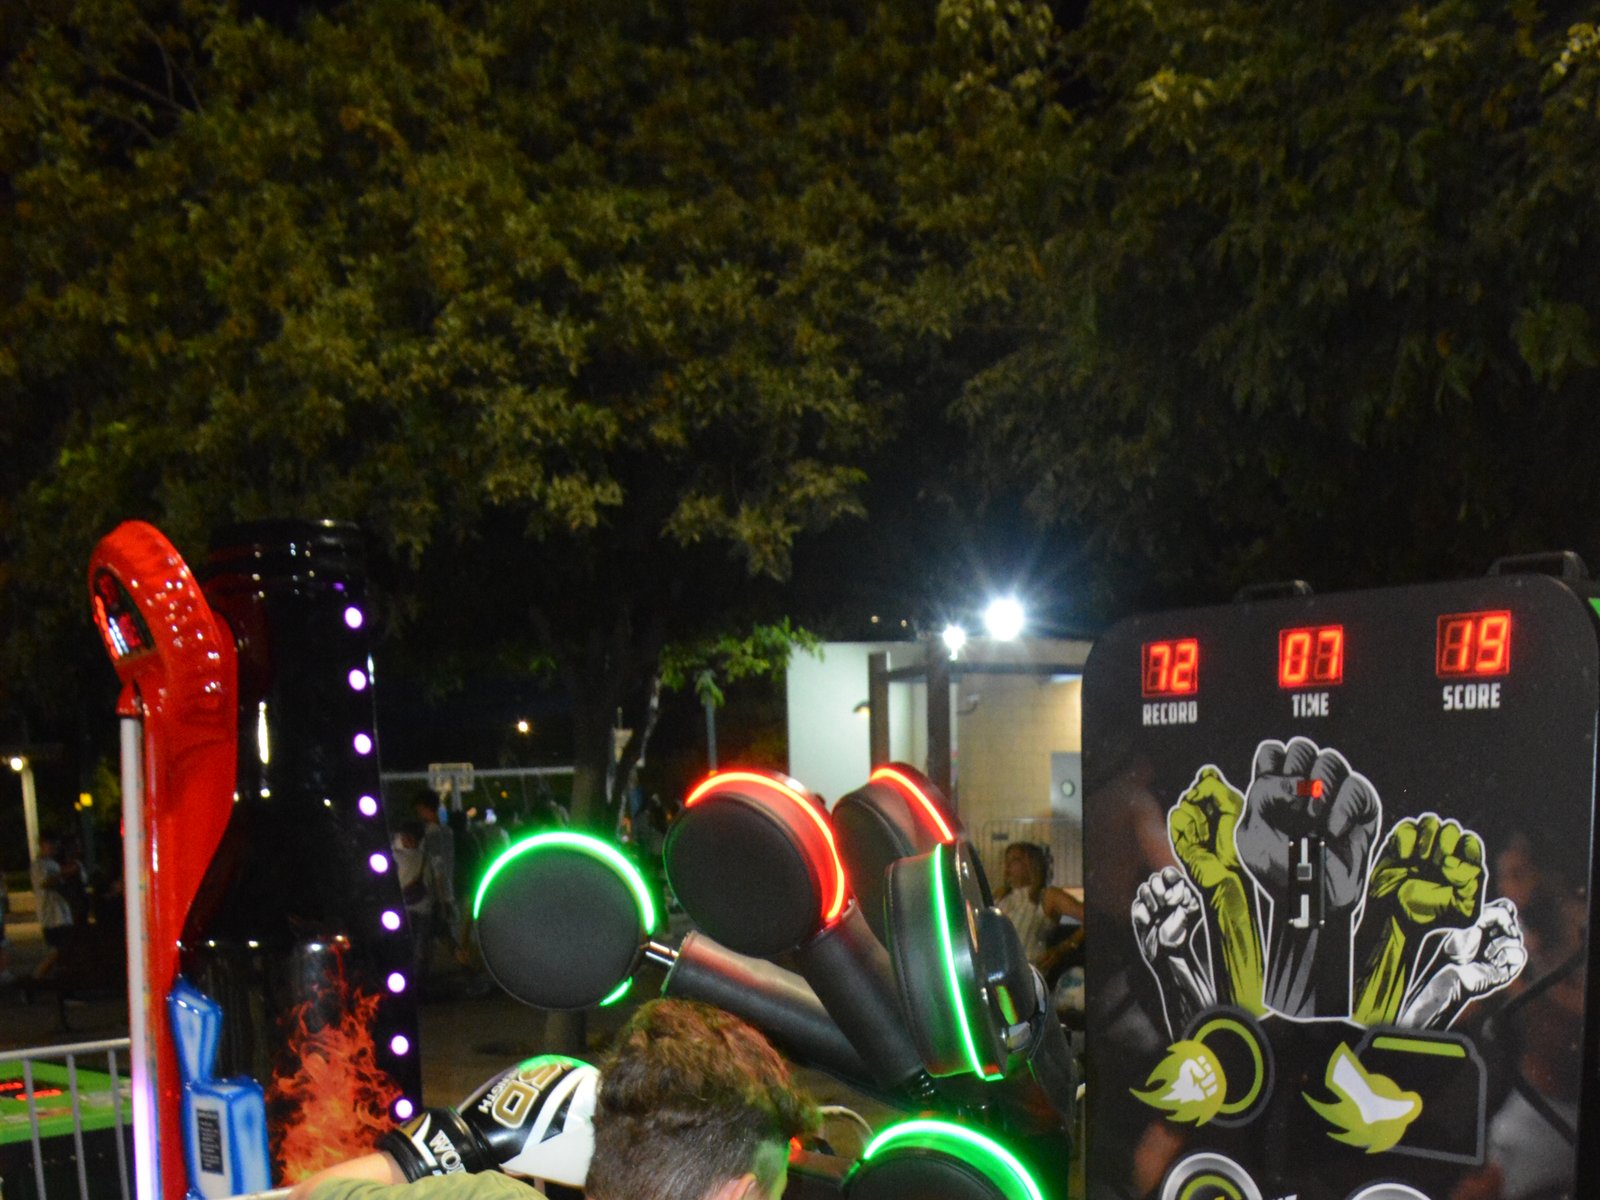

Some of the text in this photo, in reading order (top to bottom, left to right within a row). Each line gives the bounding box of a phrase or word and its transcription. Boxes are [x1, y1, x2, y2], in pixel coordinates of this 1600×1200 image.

[1282, 631, 1342, 684] 07
[1456, 615, 1509, 672] 19
[1149, 642, 1198, 692] 72
[1142, 700, 1198, 726] RECORD
[1291, 692, 1330, 718] TIME
[1442, 682, 1501, 711] SCORE
